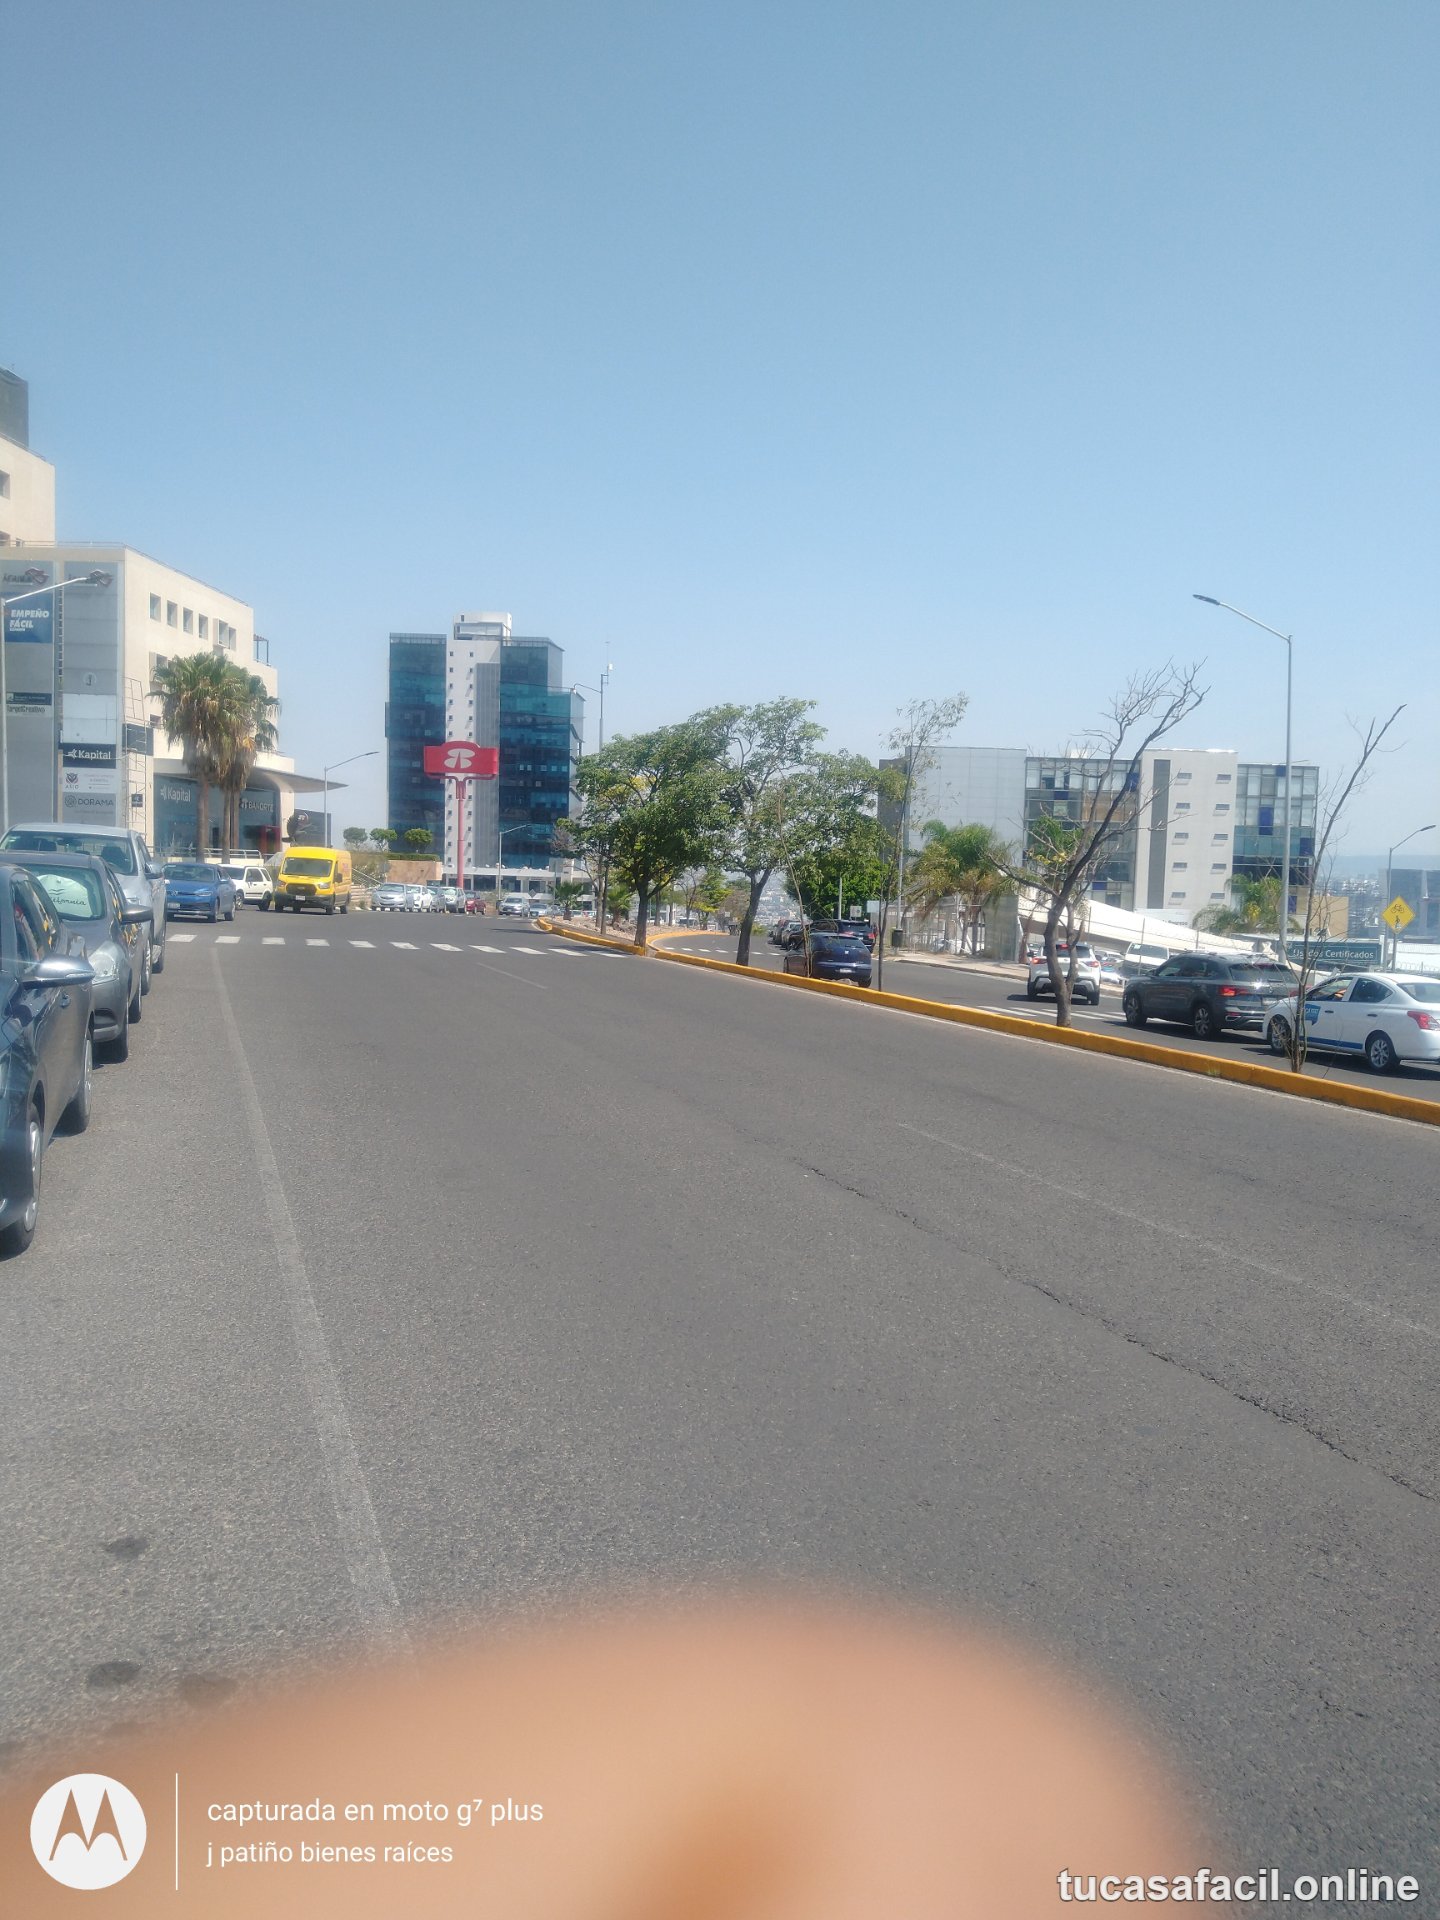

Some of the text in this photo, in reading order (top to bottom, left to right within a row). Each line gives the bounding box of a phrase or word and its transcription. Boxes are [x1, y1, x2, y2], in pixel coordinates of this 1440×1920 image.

[10, 608, 50, 618] EMPEÑO
[9, 618, 34, 628] FÁCIL
[78, 749, 111, 760] Kapital
[167, 786, 191, 803] Kapital
[77, 798, 114, 806] DORAMA
[1293, 948, 1374, 959] Usdos Certificados
